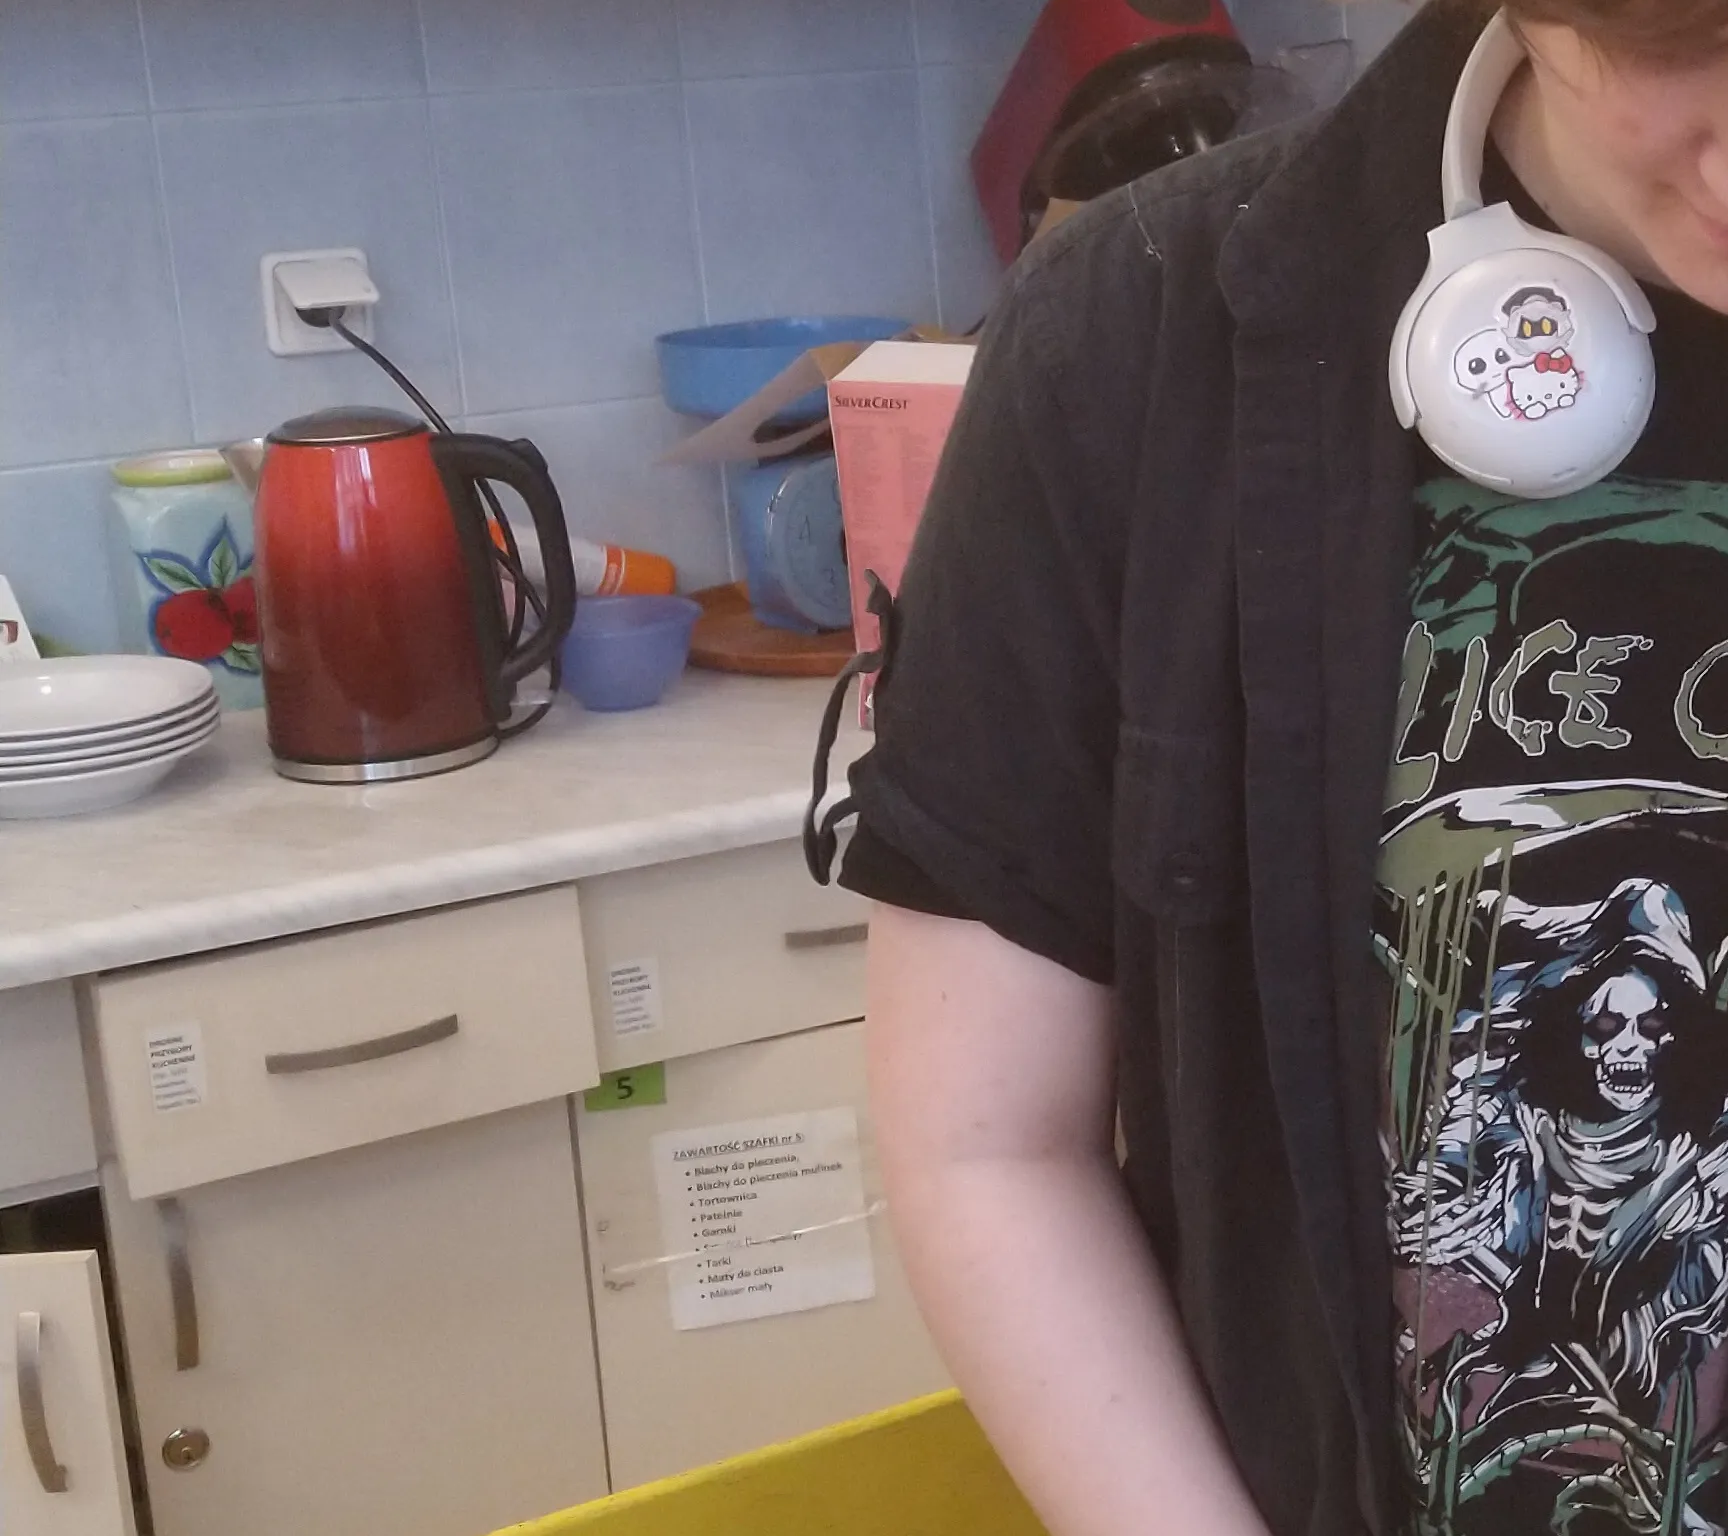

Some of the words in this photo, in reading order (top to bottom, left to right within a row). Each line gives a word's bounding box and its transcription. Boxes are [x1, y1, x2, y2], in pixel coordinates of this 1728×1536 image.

[1383, 620, 1653, 813] LICE
[616, 1076, 634, 1100] 5
[673, 1140, 740, 1161] ZAWARTOŚĆ
